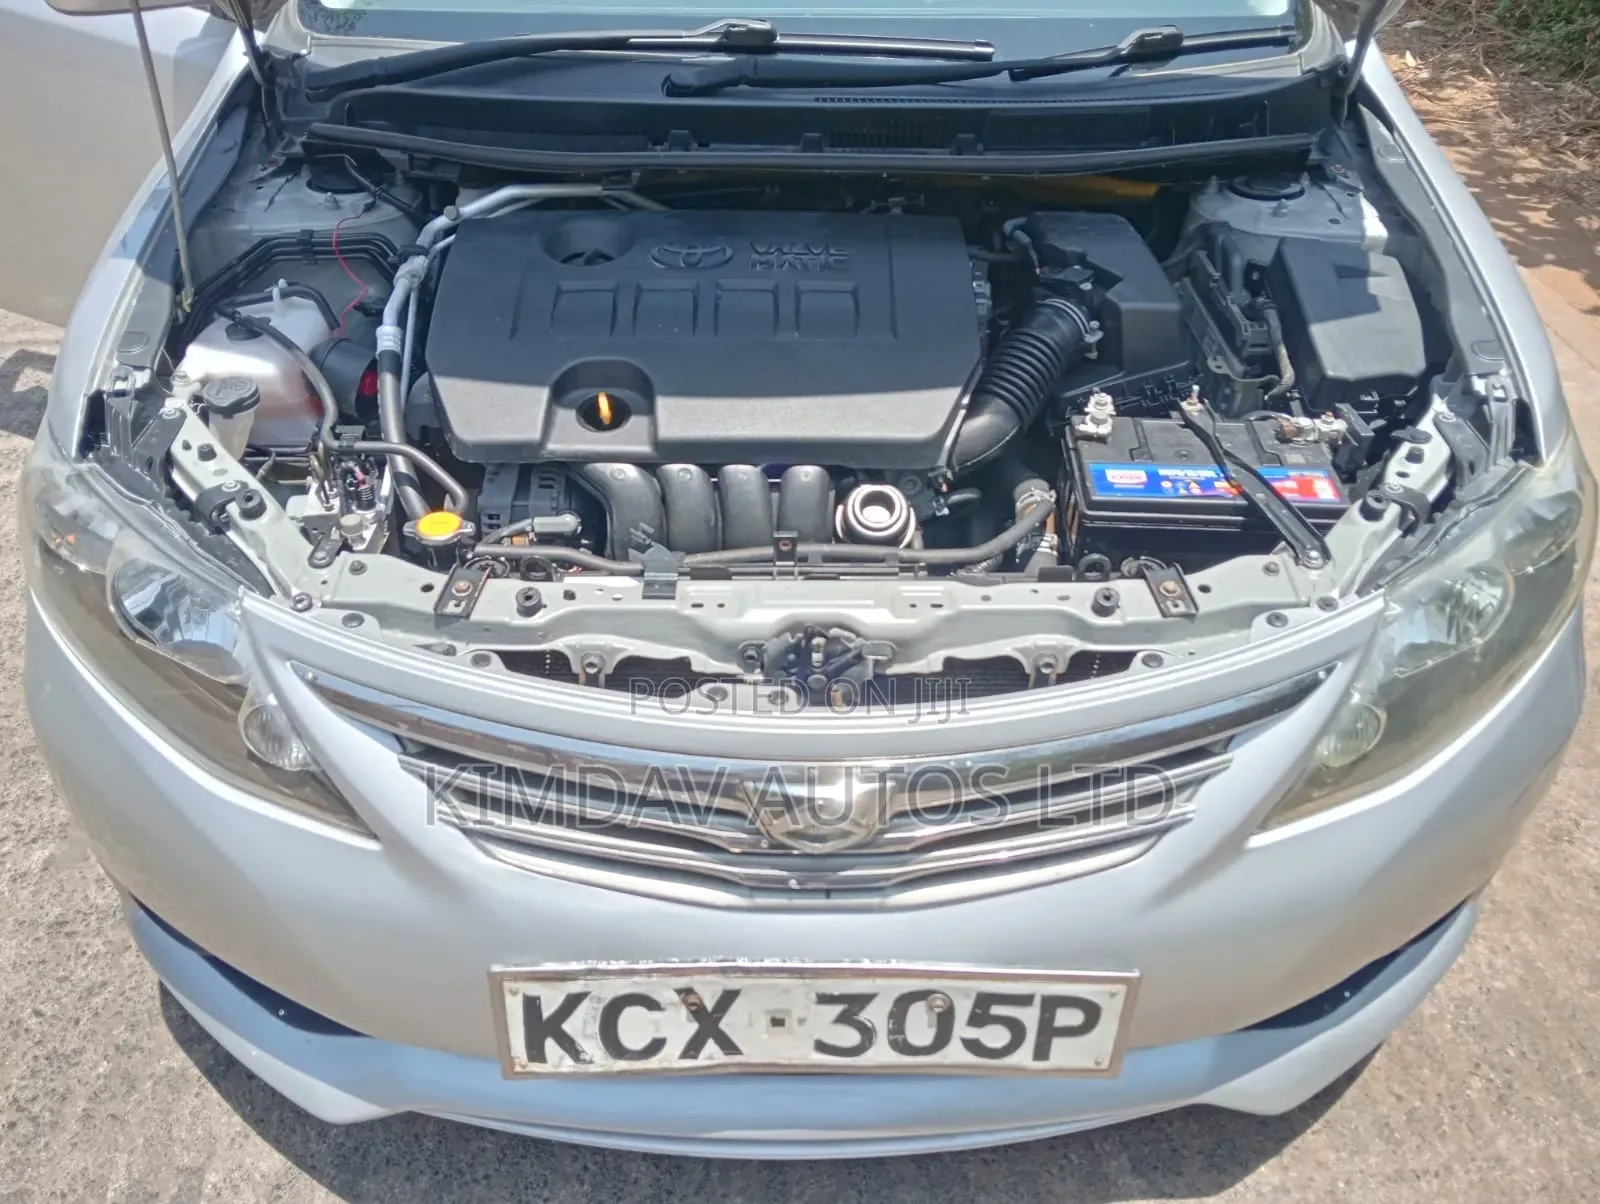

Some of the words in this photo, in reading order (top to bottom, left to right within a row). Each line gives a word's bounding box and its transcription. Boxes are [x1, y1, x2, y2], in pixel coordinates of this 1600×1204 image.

[750, 241, 848, 258] VALVE
[748, 256, 848, 271] MATIC
[522, 986, 744, 1064] KCX
[813, 989, 1103, 1062] 305P
